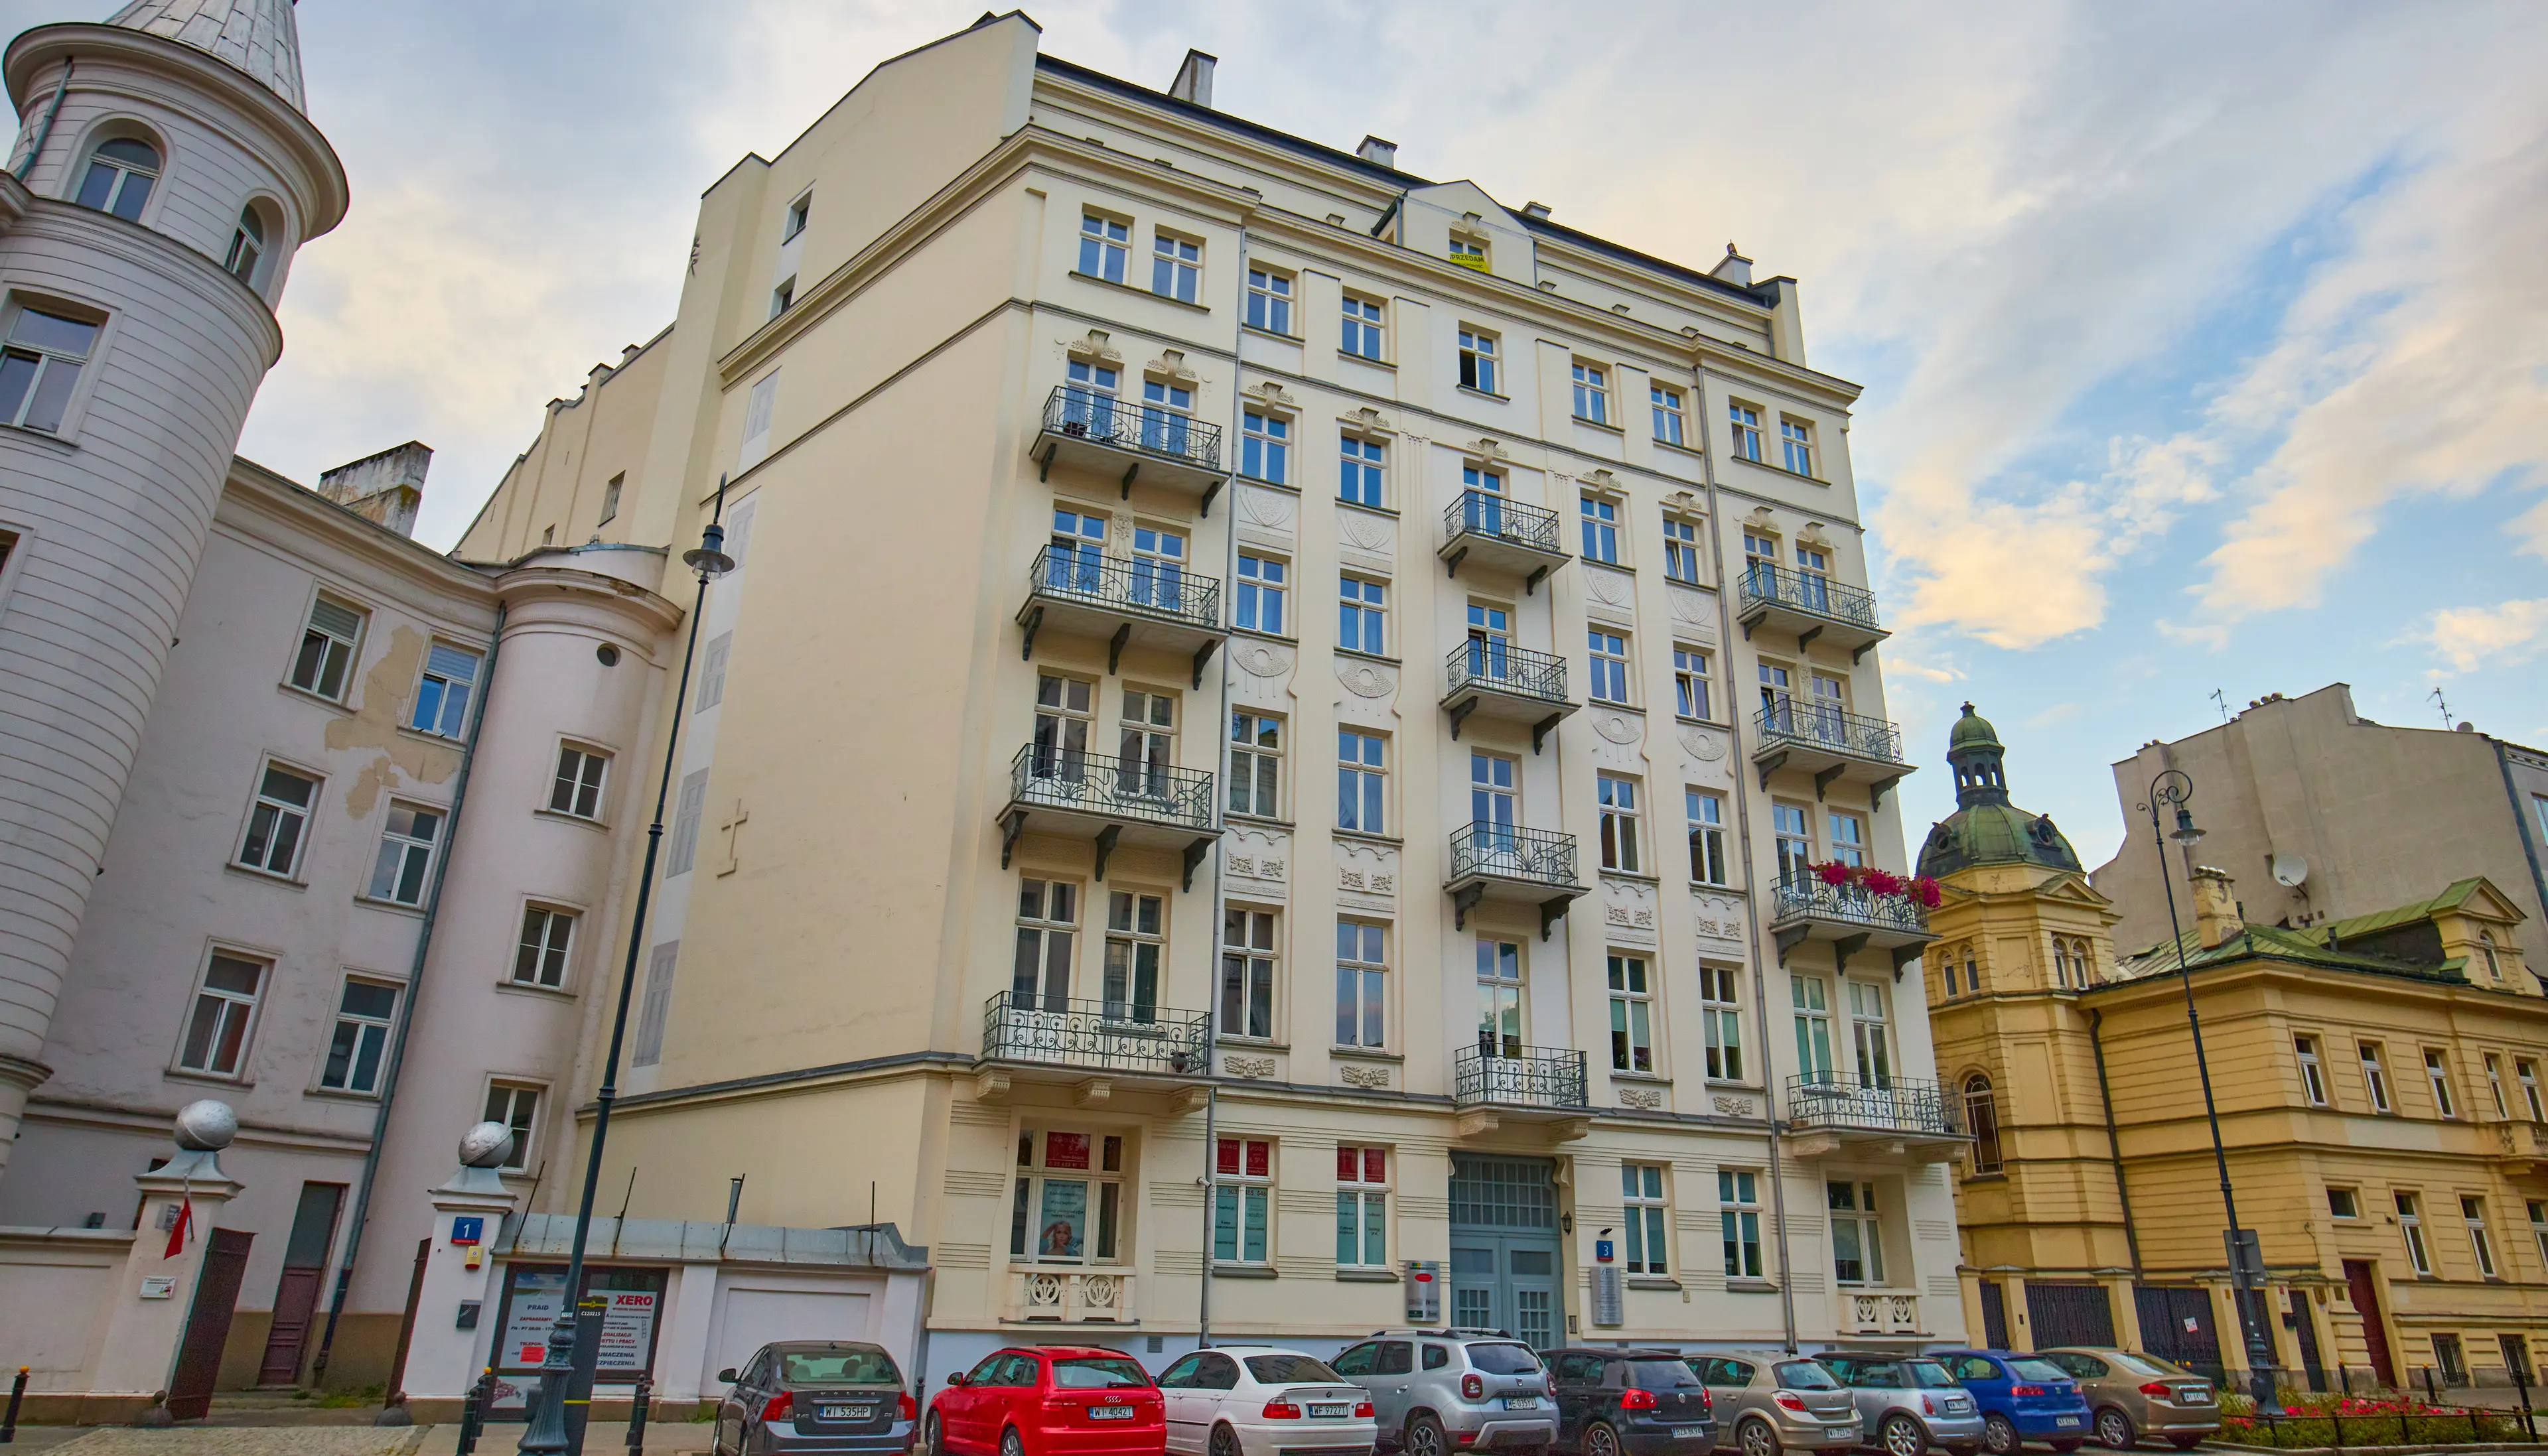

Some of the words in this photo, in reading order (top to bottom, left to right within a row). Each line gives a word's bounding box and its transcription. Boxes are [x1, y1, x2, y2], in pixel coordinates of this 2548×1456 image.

[464, 1223, 470, 1238] 1
[1604, 1245, 1609, 1256] 3
[615, 1294, 653, 1305] XERO
[841, 1407, 869, 1417] 535HP
[1109, 1408, 1131, 1416] 4042T
[1314, 1406, 1322, 1415] WF
[1325, 1406, 1346, 1415] 9727T
